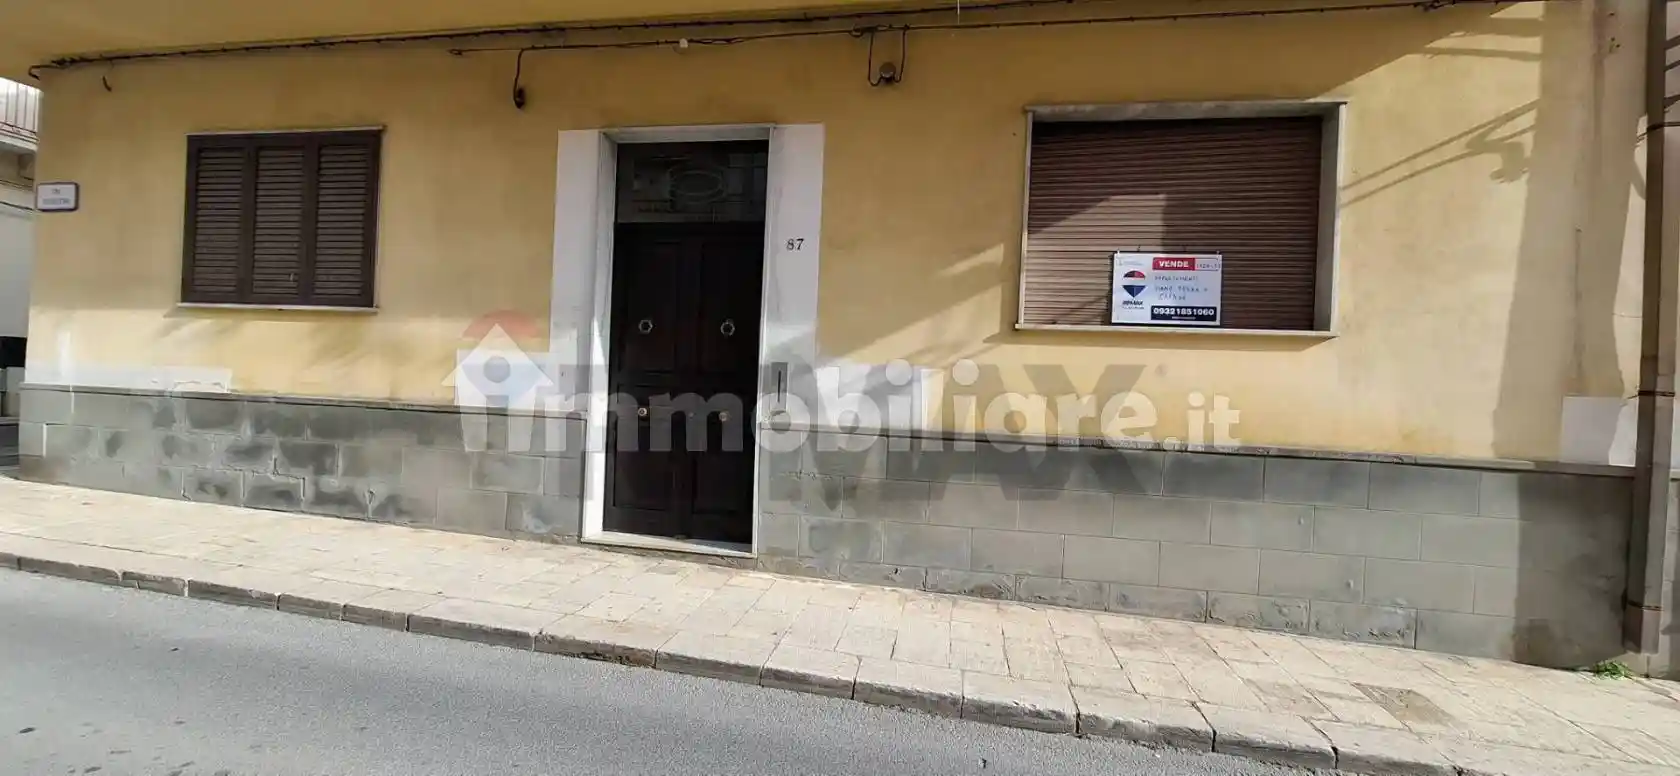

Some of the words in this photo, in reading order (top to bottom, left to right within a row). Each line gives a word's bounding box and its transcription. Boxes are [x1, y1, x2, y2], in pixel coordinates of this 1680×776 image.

[786, 238, 804, 250] 87
[1159, 260, 1189, 268] VENDE
[1153, 307, 1215, 316] 09321851060
